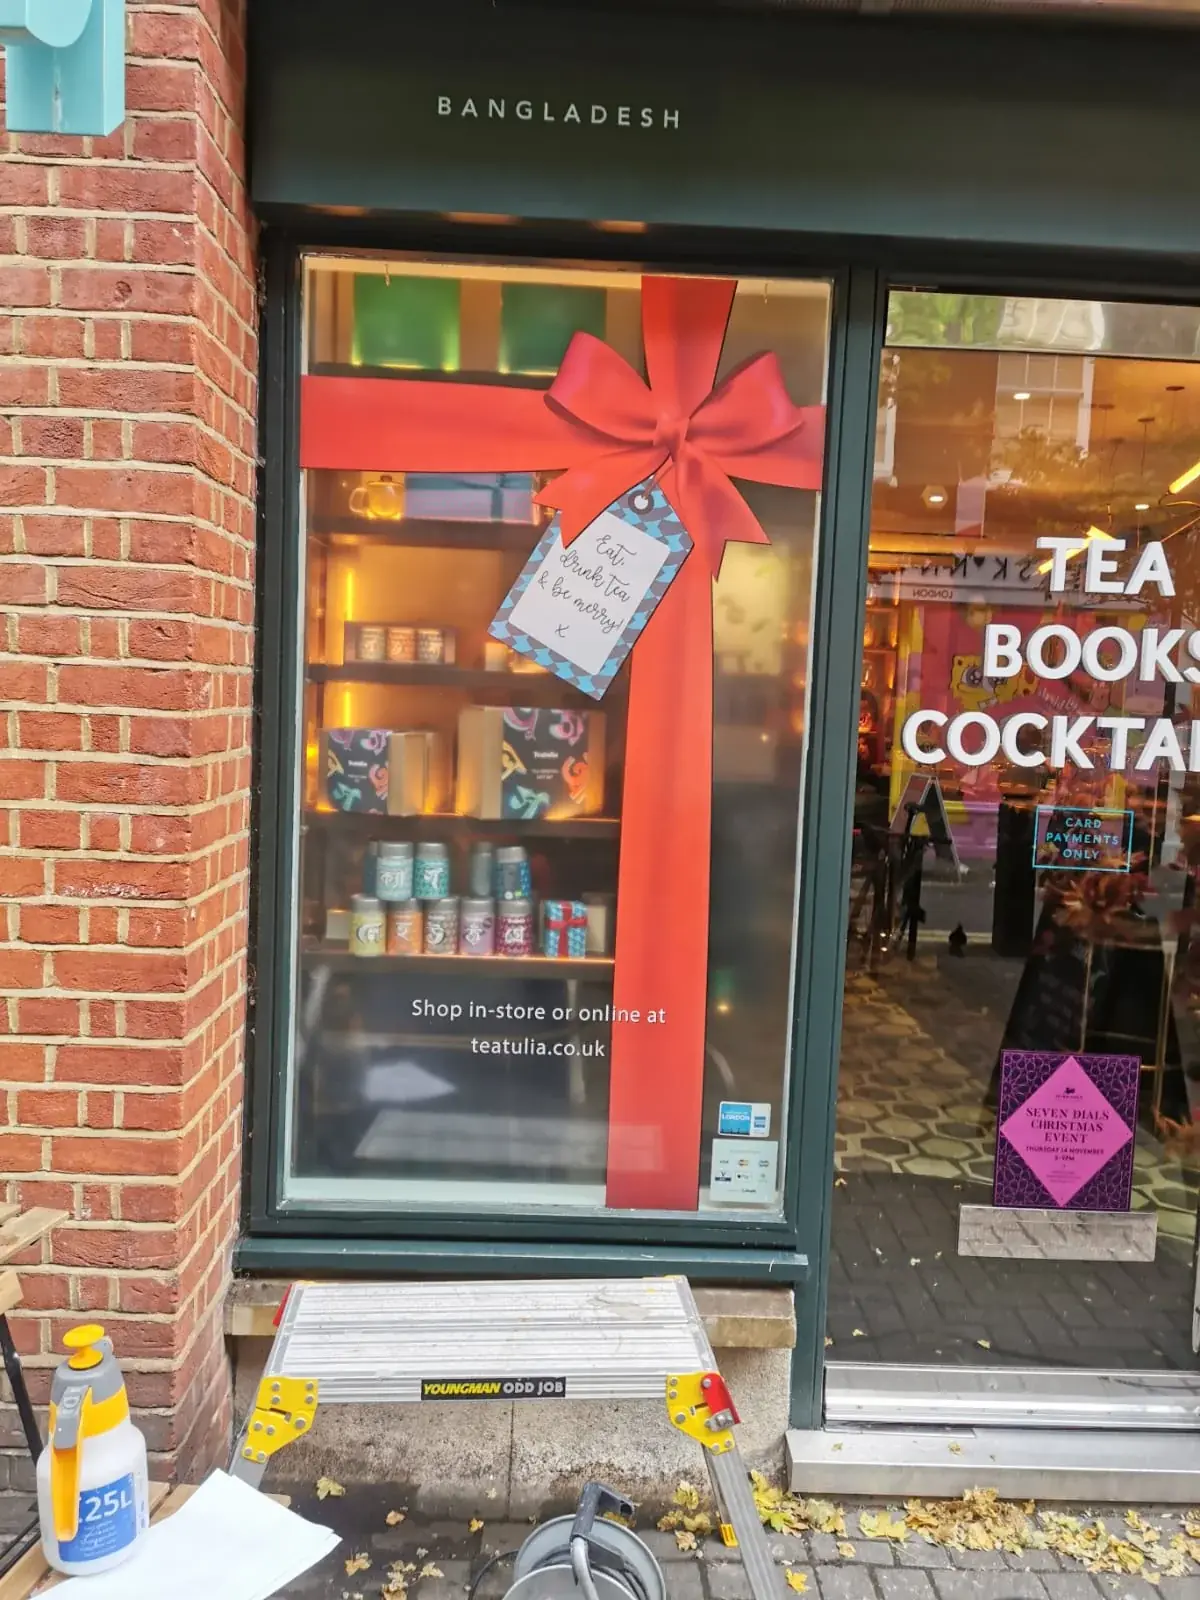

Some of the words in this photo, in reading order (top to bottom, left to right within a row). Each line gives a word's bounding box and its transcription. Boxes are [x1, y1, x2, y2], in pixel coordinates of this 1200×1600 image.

[437, 96, 679, 129] BANGLADESH
[560, 549, 604, 588] drink
[1036, 536, 1176, 596] TEA
[537, 570, 548, 590] &
[552, 576, 572, 600] be
[573, 597, 624, 634] merry!
[1065, 817, 1102, 829] CARD
[1046, 832, 1120, 845] PAYMENTS
[1062, 849, 1100, 860] ONLY
[411, 999, 462, 1021] Shop
[469, 1001, 545, 1020] in-store
[552, 1006, 571, 1021] or
[578, 1004, 640, 1022] online
[646, 1008, 666, 1023] at
[471, 1037, 605, 1057] teatulia.co.uk
[1026, 1107, 1068, 1118] SEVEN
[1073, 1109, 1109, 1120] DIALS
[1031, 1120, 1103, 1132] CHRISTMAS
[1045, 1132, 1088, 1144] EVENT
[423, 1382, 501, 1395] YOUNGMAN
[503, 1382, 535, 1394] ODD
[537, 1382, 564, 1396] JOB
